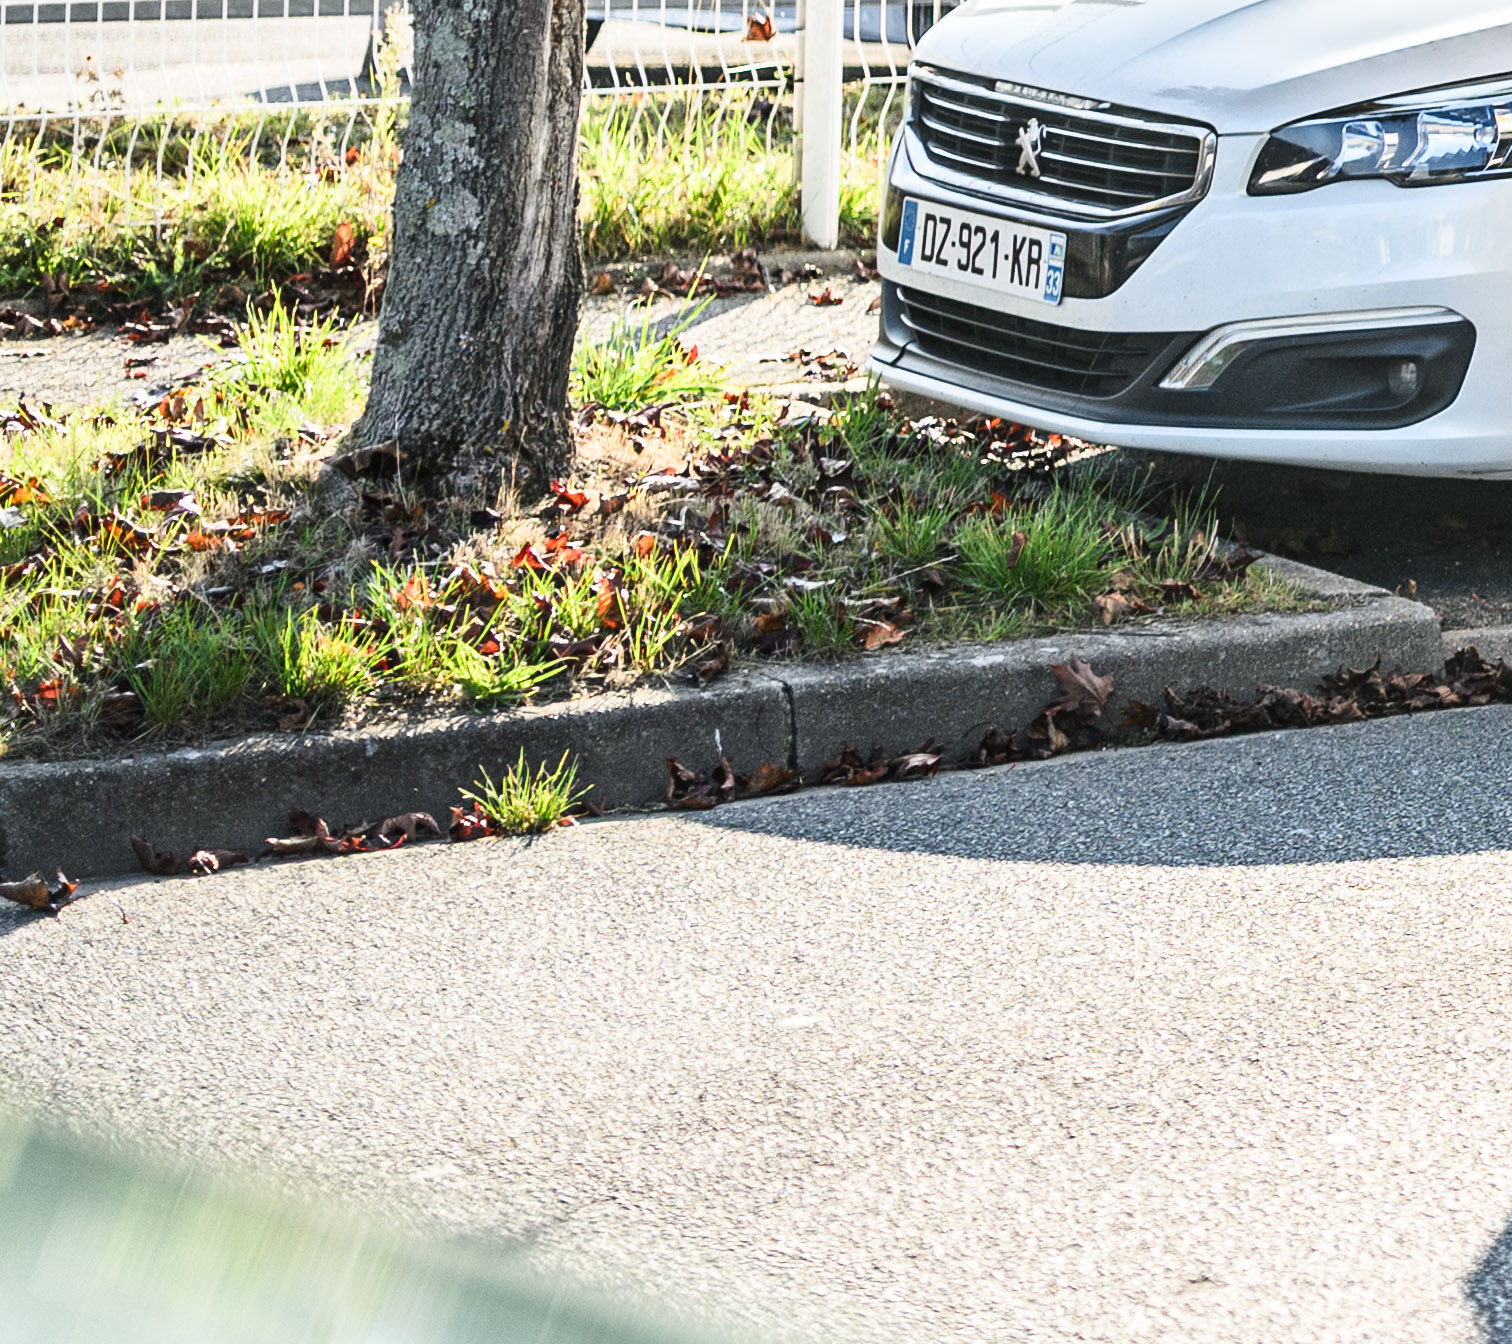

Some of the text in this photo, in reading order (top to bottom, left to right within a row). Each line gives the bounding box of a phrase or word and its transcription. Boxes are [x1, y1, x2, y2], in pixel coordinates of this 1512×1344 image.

[903, 213, 1062, 296] F DZ-921-KR 33
